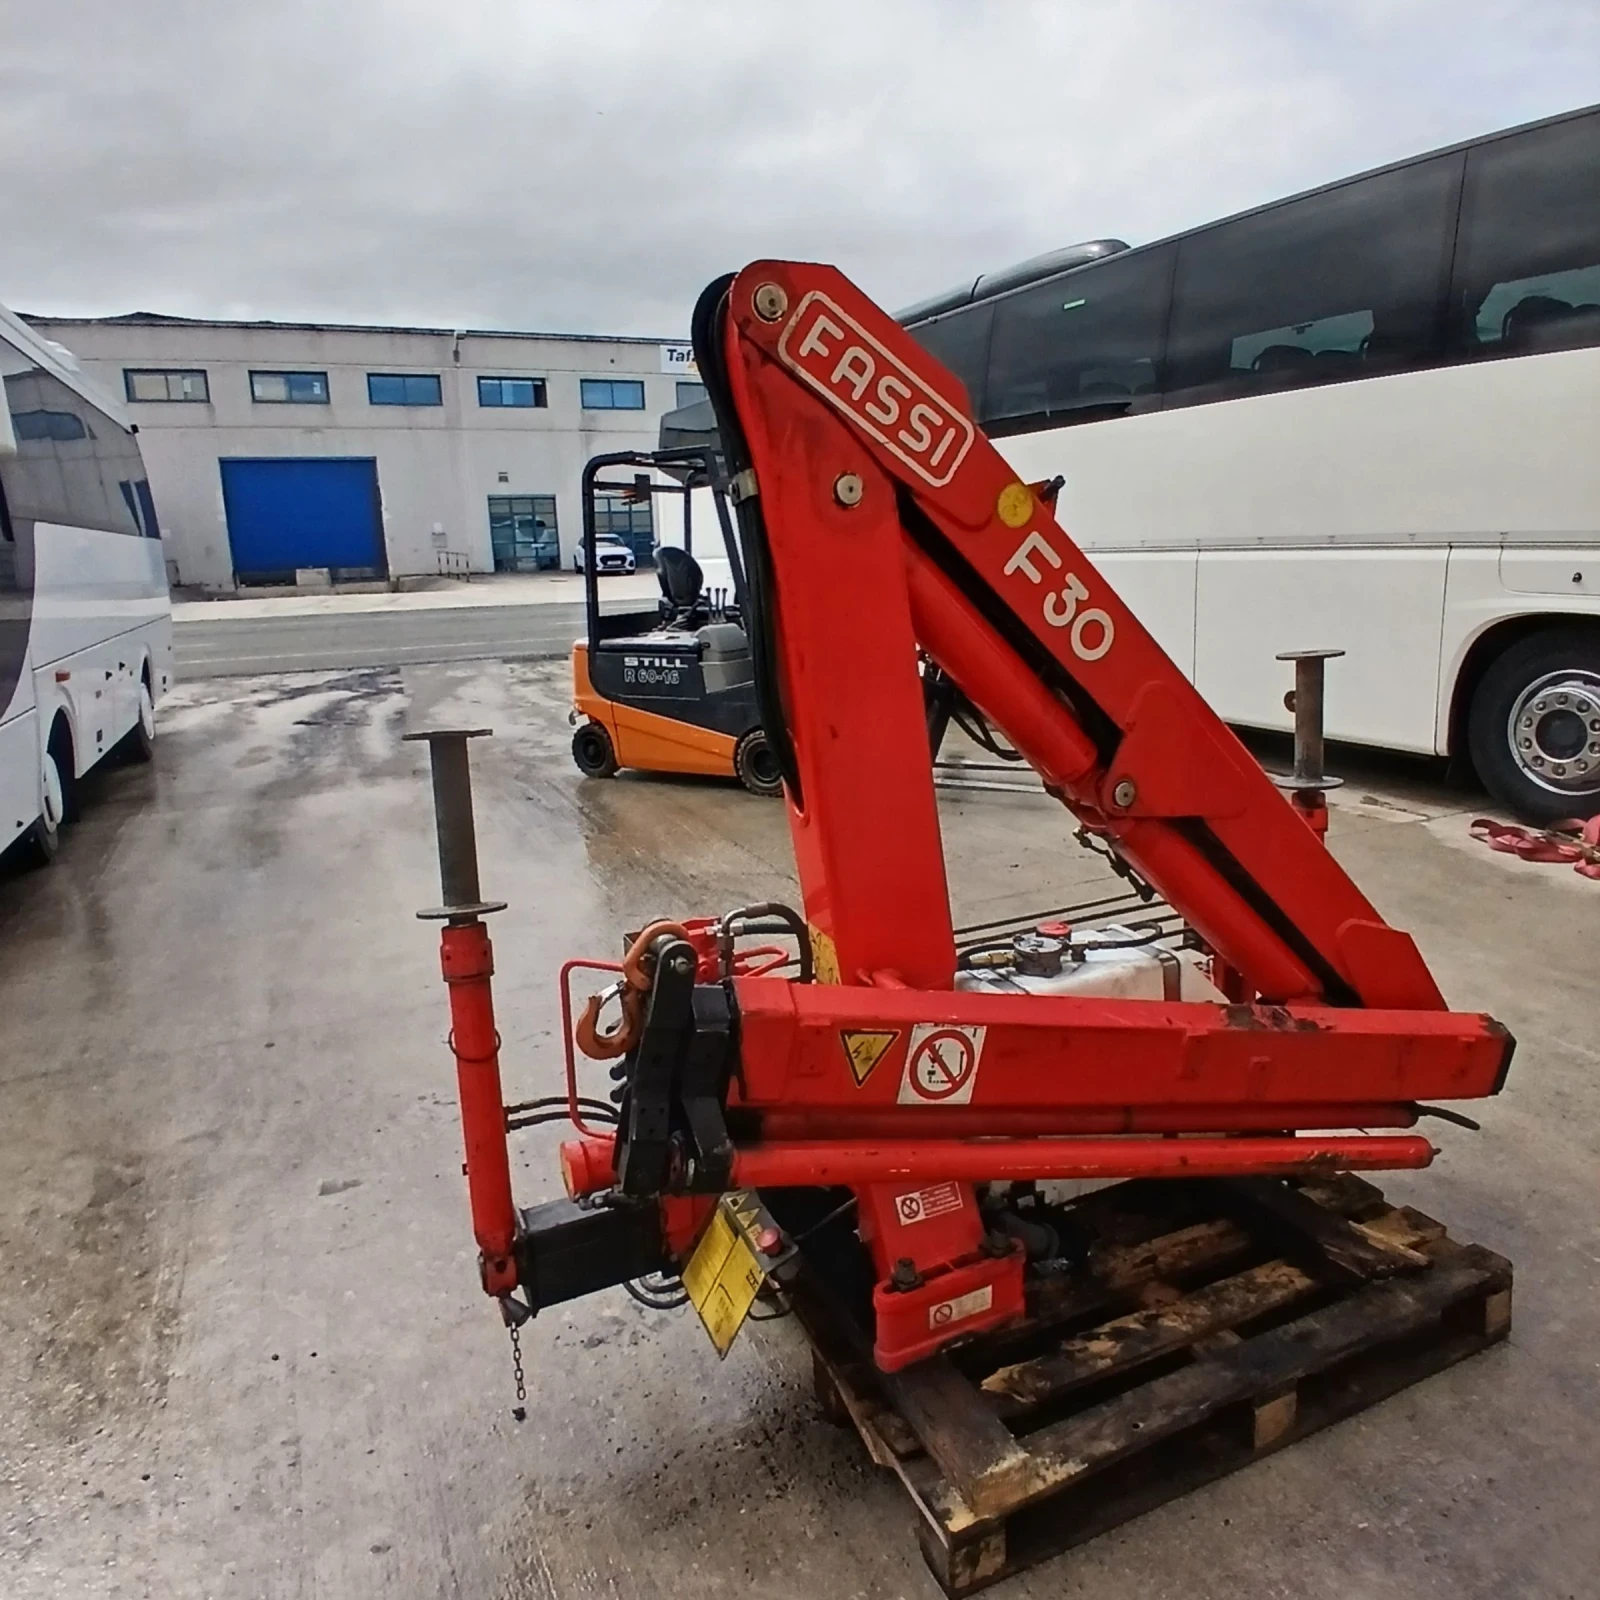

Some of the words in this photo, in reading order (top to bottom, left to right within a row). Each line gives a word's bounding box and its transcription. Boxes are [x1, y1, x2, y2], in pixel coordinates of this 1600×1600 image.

[667, 348, 696, 362] Taf
[800, 314, 956, 466] FASSI
[1003, 531, 1115, 661] F30
[624, 657, 689, 668] STILL
[624, 668, 635, 682] R
[638, 669, 680, 685] 60-16
